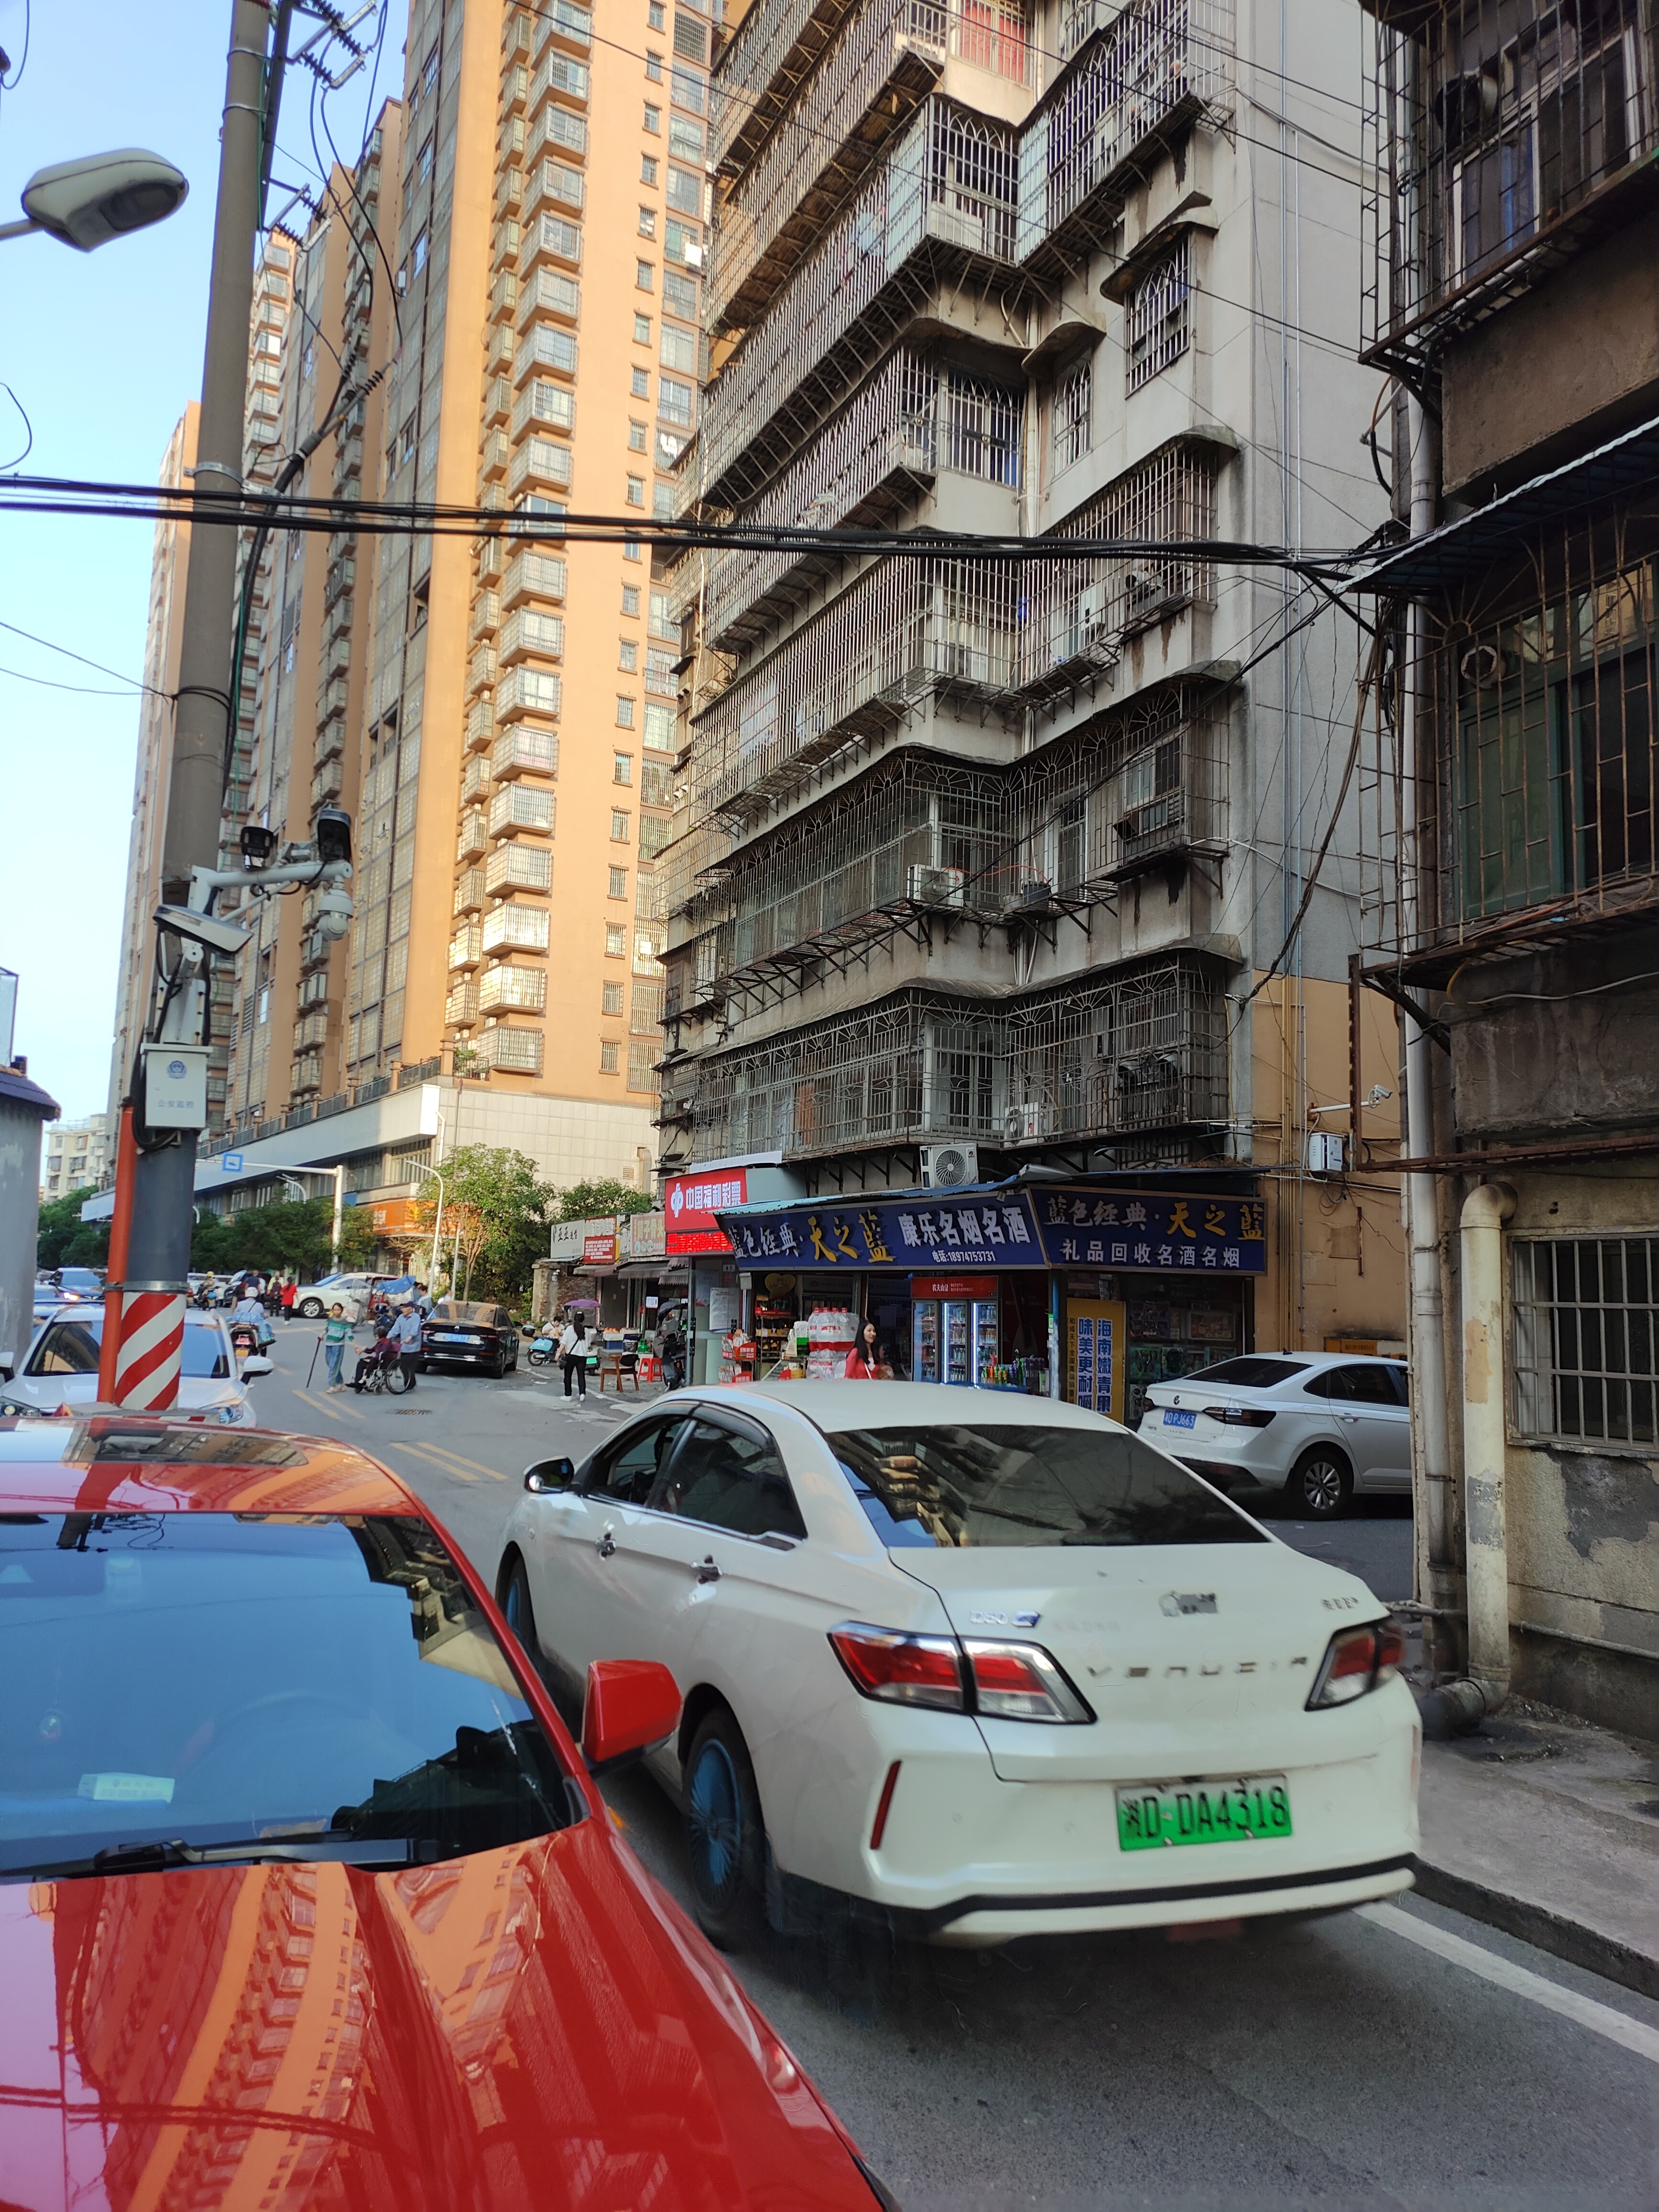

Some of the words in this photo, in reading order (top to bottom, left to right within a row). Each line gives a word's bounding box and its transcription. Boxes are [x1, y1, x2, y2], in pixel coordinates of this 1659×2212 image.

[686, 1181, 741, 1210] 中国福利彩票
[897, 1206, 1030, 1247] 康乐名烟名酒
[1061, 1239, 1239, 1268] 礼品回收名酒名烟
[932, 1283, 949, 1292] 农夫山泉
[1096, 1318, 1112, 1413] 海南嫩青果
